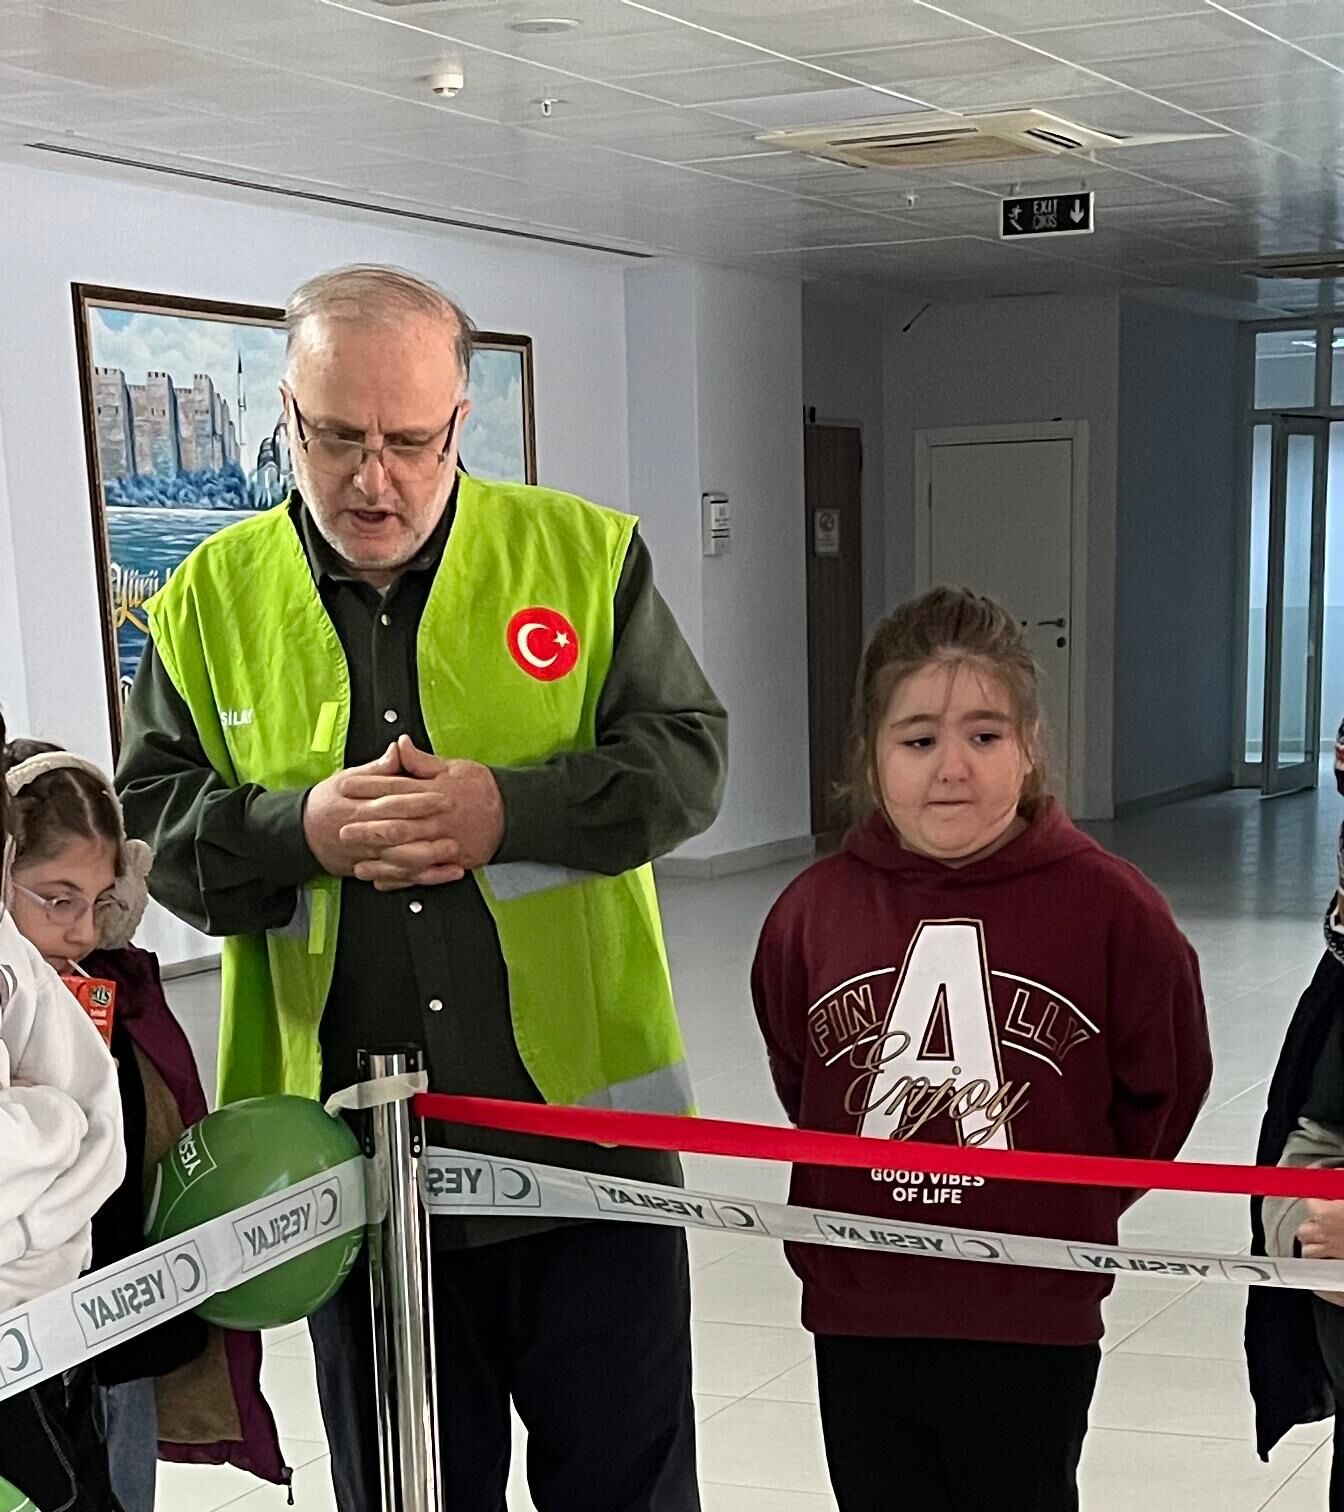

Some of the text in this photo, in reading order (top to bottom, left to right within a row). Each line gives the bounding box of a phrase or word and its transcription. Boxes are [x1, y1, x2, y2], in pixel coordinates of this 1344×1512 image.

[1033, 198, 1059, 214] EXIT
[844, 1029, 1031, 1148] Enjoy
[870, 1167, 924, 1186] GOOD
[892, 1188, 963, 1205] OF LIFE
